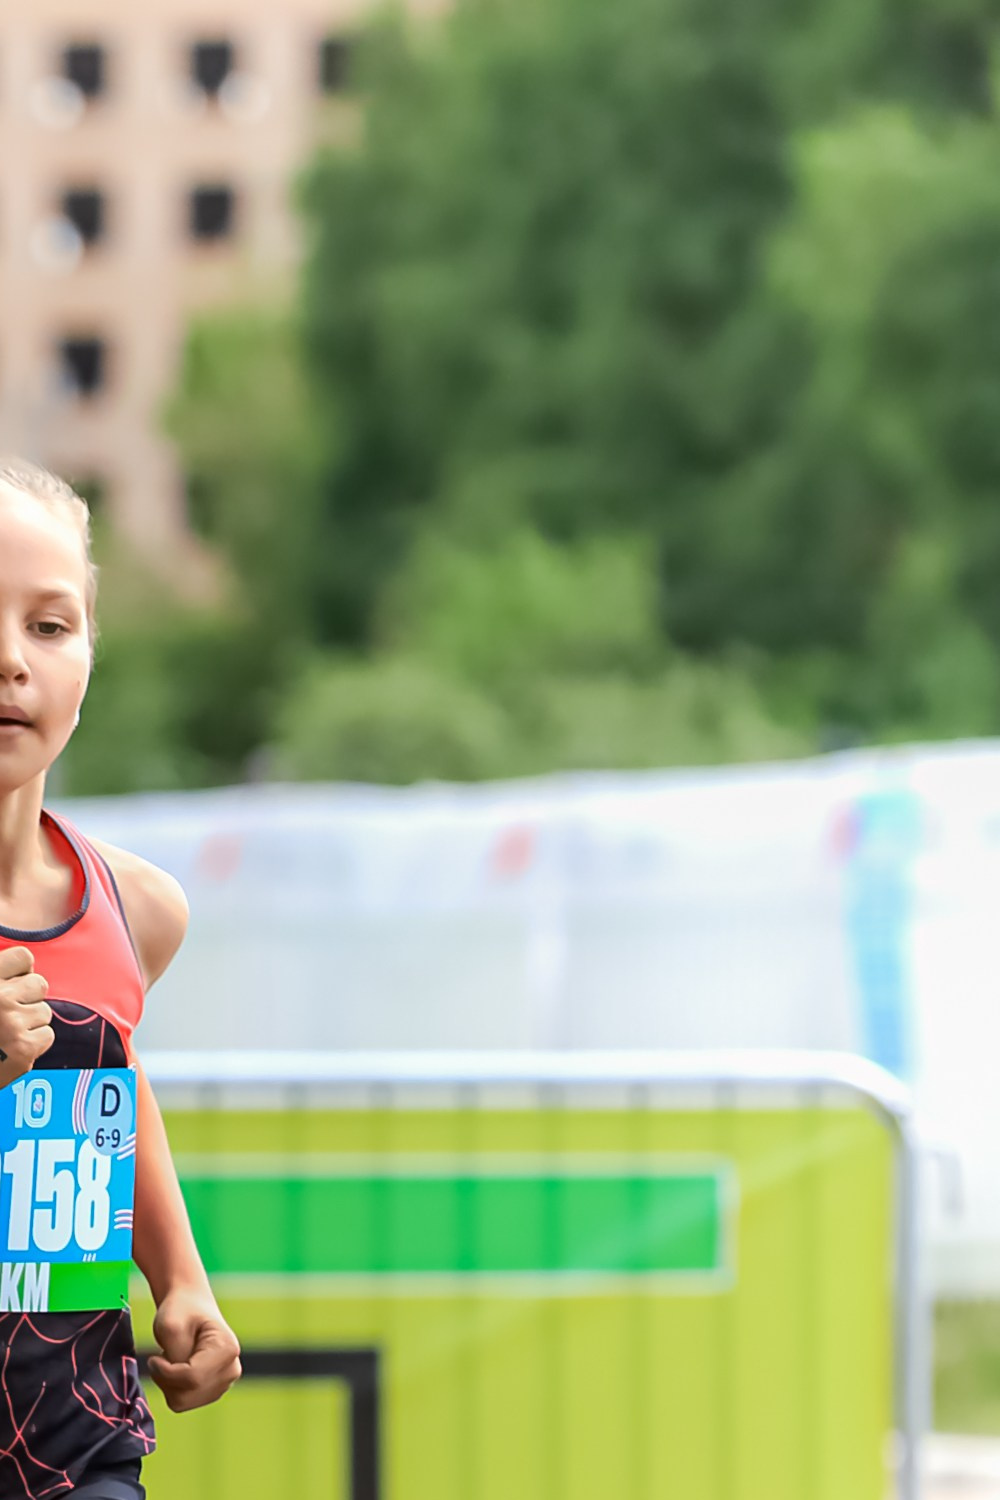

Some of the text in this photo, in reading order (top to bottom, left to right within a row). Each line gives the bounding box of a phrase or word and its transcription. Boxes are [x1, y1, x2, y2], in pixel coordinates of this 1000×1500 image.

[11, 1078, 53, 1129] 10
[100, 1083, 121, 1117] D
[95, 1128, 121, 1149] 6-9
